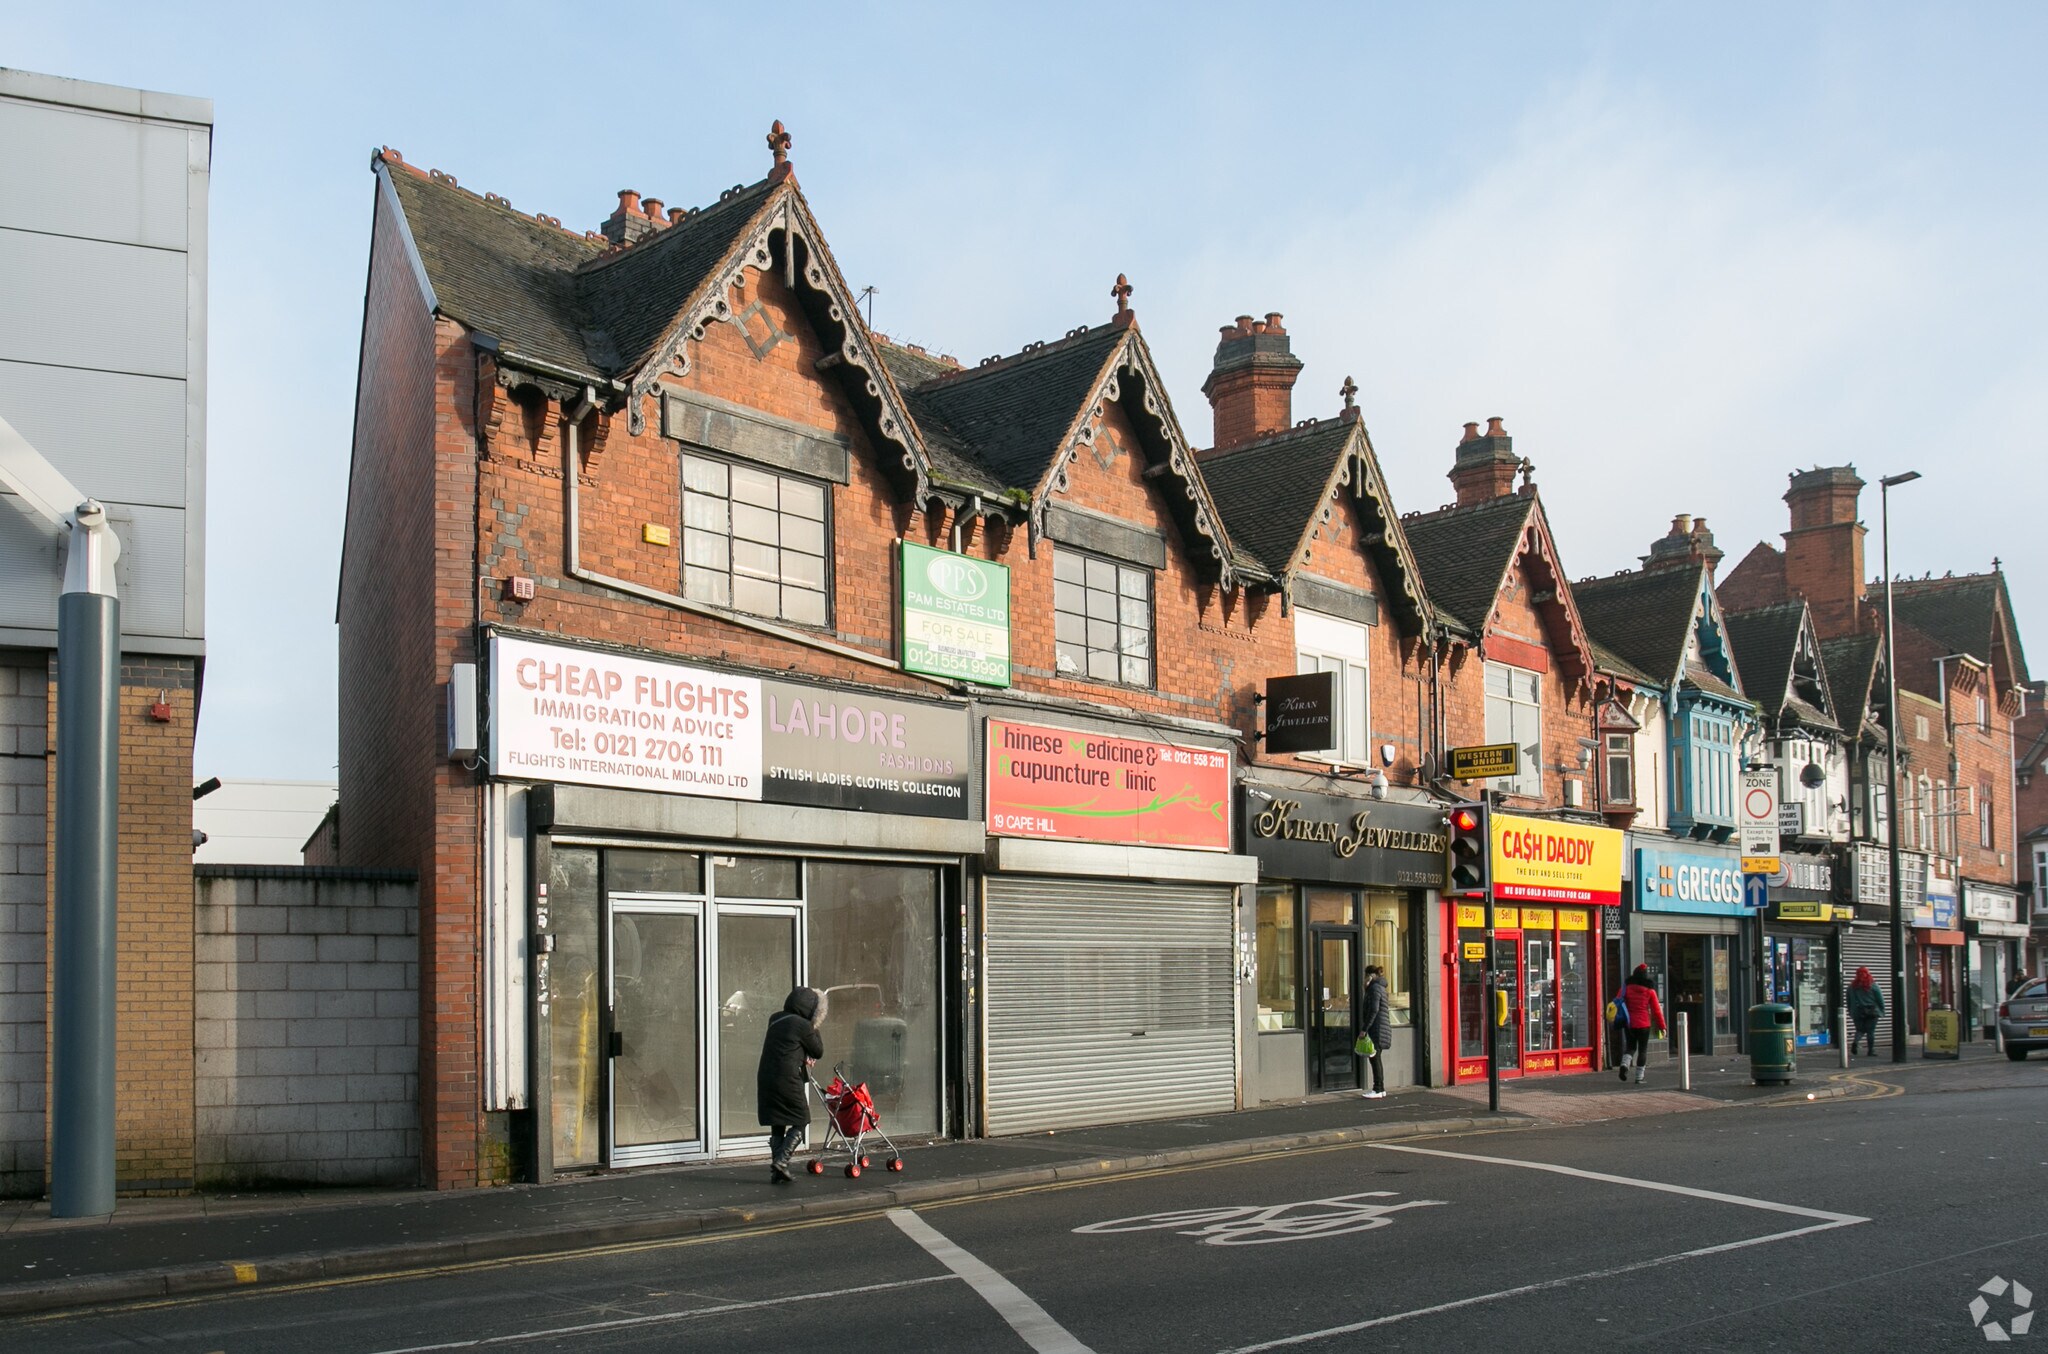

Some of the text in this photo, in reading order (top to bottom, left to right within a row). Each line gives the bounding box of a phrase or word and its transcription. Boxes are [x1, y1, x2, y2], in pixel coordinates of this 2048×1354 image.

[941, 561, 977, 595] PPS
[908, 591, 1006, 622] PAM ESTATES LTD
[922, 621, 952, 638] FOR
[957, 627, 992, 645] SALE
[908, 648, 1006, 678] 0121 554 9990
[516, 658, 749, 719] CHEAP FLIGHTS
[534, 697, 734, 740] IMMIGRATION ADVICE
[1278, 697, 1318, 712] KIRAN
[769, 695, 906, 748] LAHORE
[1268, 714, 1329, 732] JEWELLERS
[550, 726, 722, 767] Tel: 0121 2706 111
[992, 725, 1158, 766] Chinese Medicine &
[1160, 749, 1225, 768] Tel: 0121 558 2111
[1457, 750, 1503, 760] WESTERN
[509, 752, 748, 788] FLIGHTS INTERNATIONAL MIDLAND LTD
[880, 752, 954, 775] FASHIONS
[998, 755, 1156, 792] Acupuncture Clinic
[1472, 758, 1503, 766] UNION
[770, 766, 961, 798] STYLISH LADIES CLOTHES COLLECTION
[1746, 778, 1772, 788] ZONE
[993, 814, 1056, 832] 19 CAPE HILL
[1255, 799, 1447, 858] KIRAN JEWELLERS
[1502, 828, 1594, 866] CA$H DADDY
[1414, 872, 1426, 884] 558
[1516, 868, 1526, 876] THE
[1540, 870, 1550, 878] AND
[1553, 871, 1565, 879] SELL
[1566, 872, 1582, 880] STORE
[1677, 864, 1744, 904] GREGGS
[1504, 886, 1513, 894] WE
[1514, 887, 1526, 896] BUY
[1526, 888, 1542, 896] GOLD
[1547, 890, 1566, 898] SILVER
[1566, 890, 1576, 898] FOR
[1578, 892, 1591, 900] CASH
